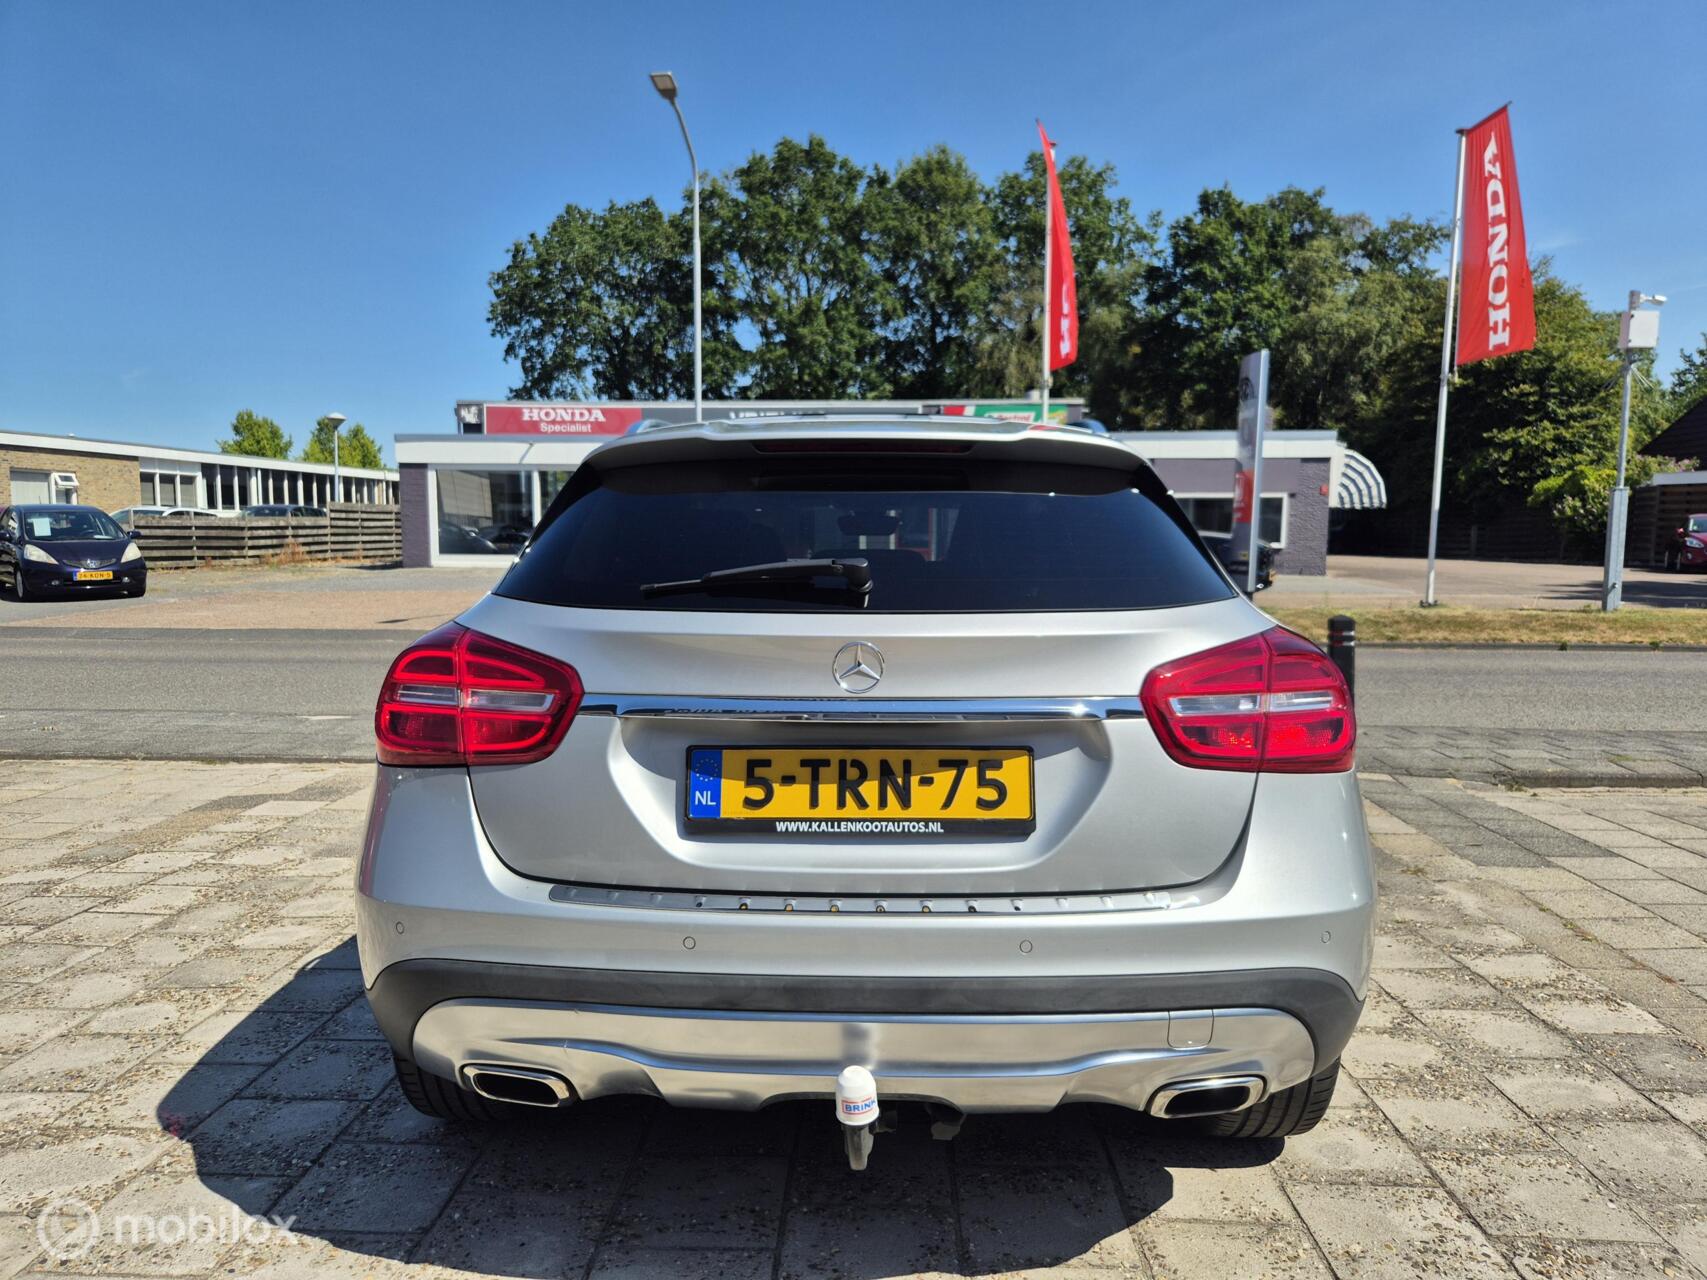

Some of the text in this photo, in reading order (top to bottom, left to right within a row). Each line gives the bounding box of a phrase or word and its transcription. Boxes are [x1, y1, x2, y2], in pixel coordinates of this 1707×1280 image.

[1484, 131, 1511, 351] HONDA
[522, 408, 606, 422] HONDA
[540, 423, 592, 434] Specialist
[742, 758, 1008, 811] 5-TRN-75
[694, 790, 717, 806] NL
[775, 821, 945, 833] WWW.KALLENKOOTAUTOS.NL
